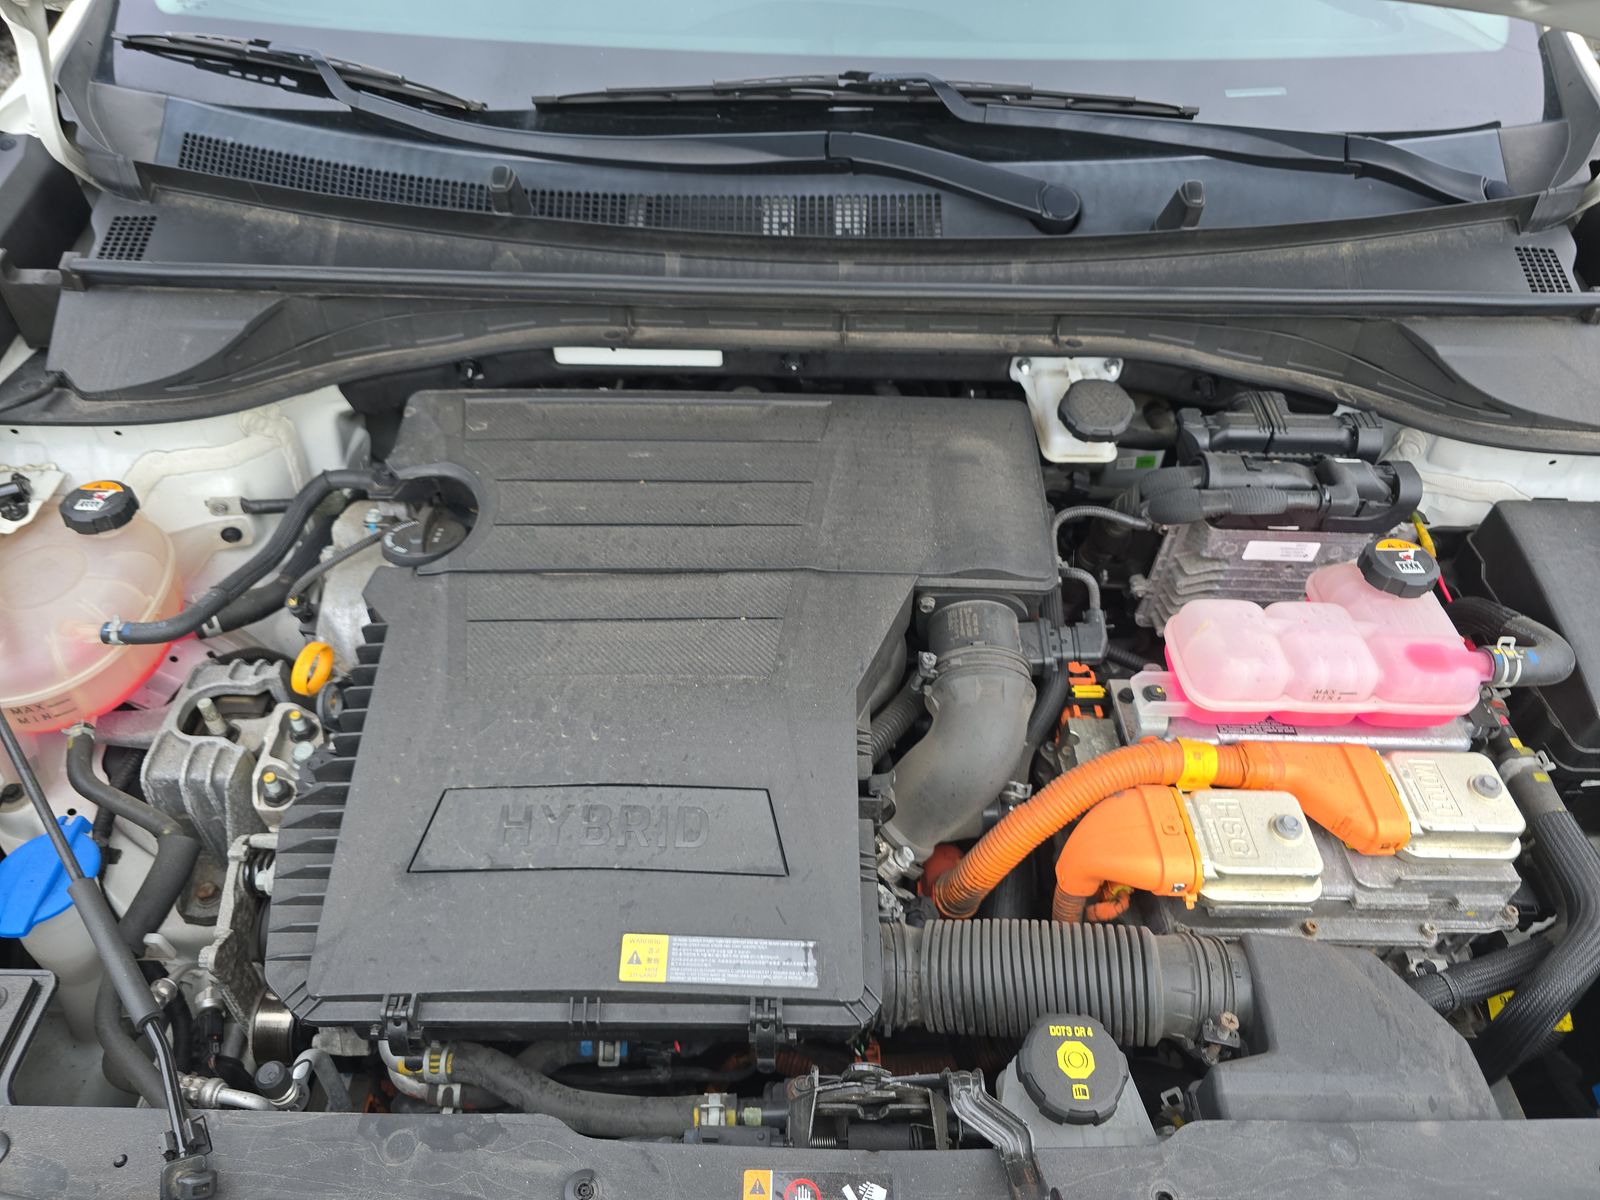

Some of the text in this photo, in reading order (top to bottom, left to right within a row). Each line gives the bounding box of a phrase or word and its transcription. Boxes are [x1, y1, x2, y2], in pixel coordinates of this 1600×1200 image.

[10, 702, 45, 715] MAX
[17, 712, 52, 725] MIN
[495, 804, 709, 849] HYBRID
[1216, 804, 1251, 856] HSG
[1049, 1025, 1093, 1037] DOT3 OR 4
